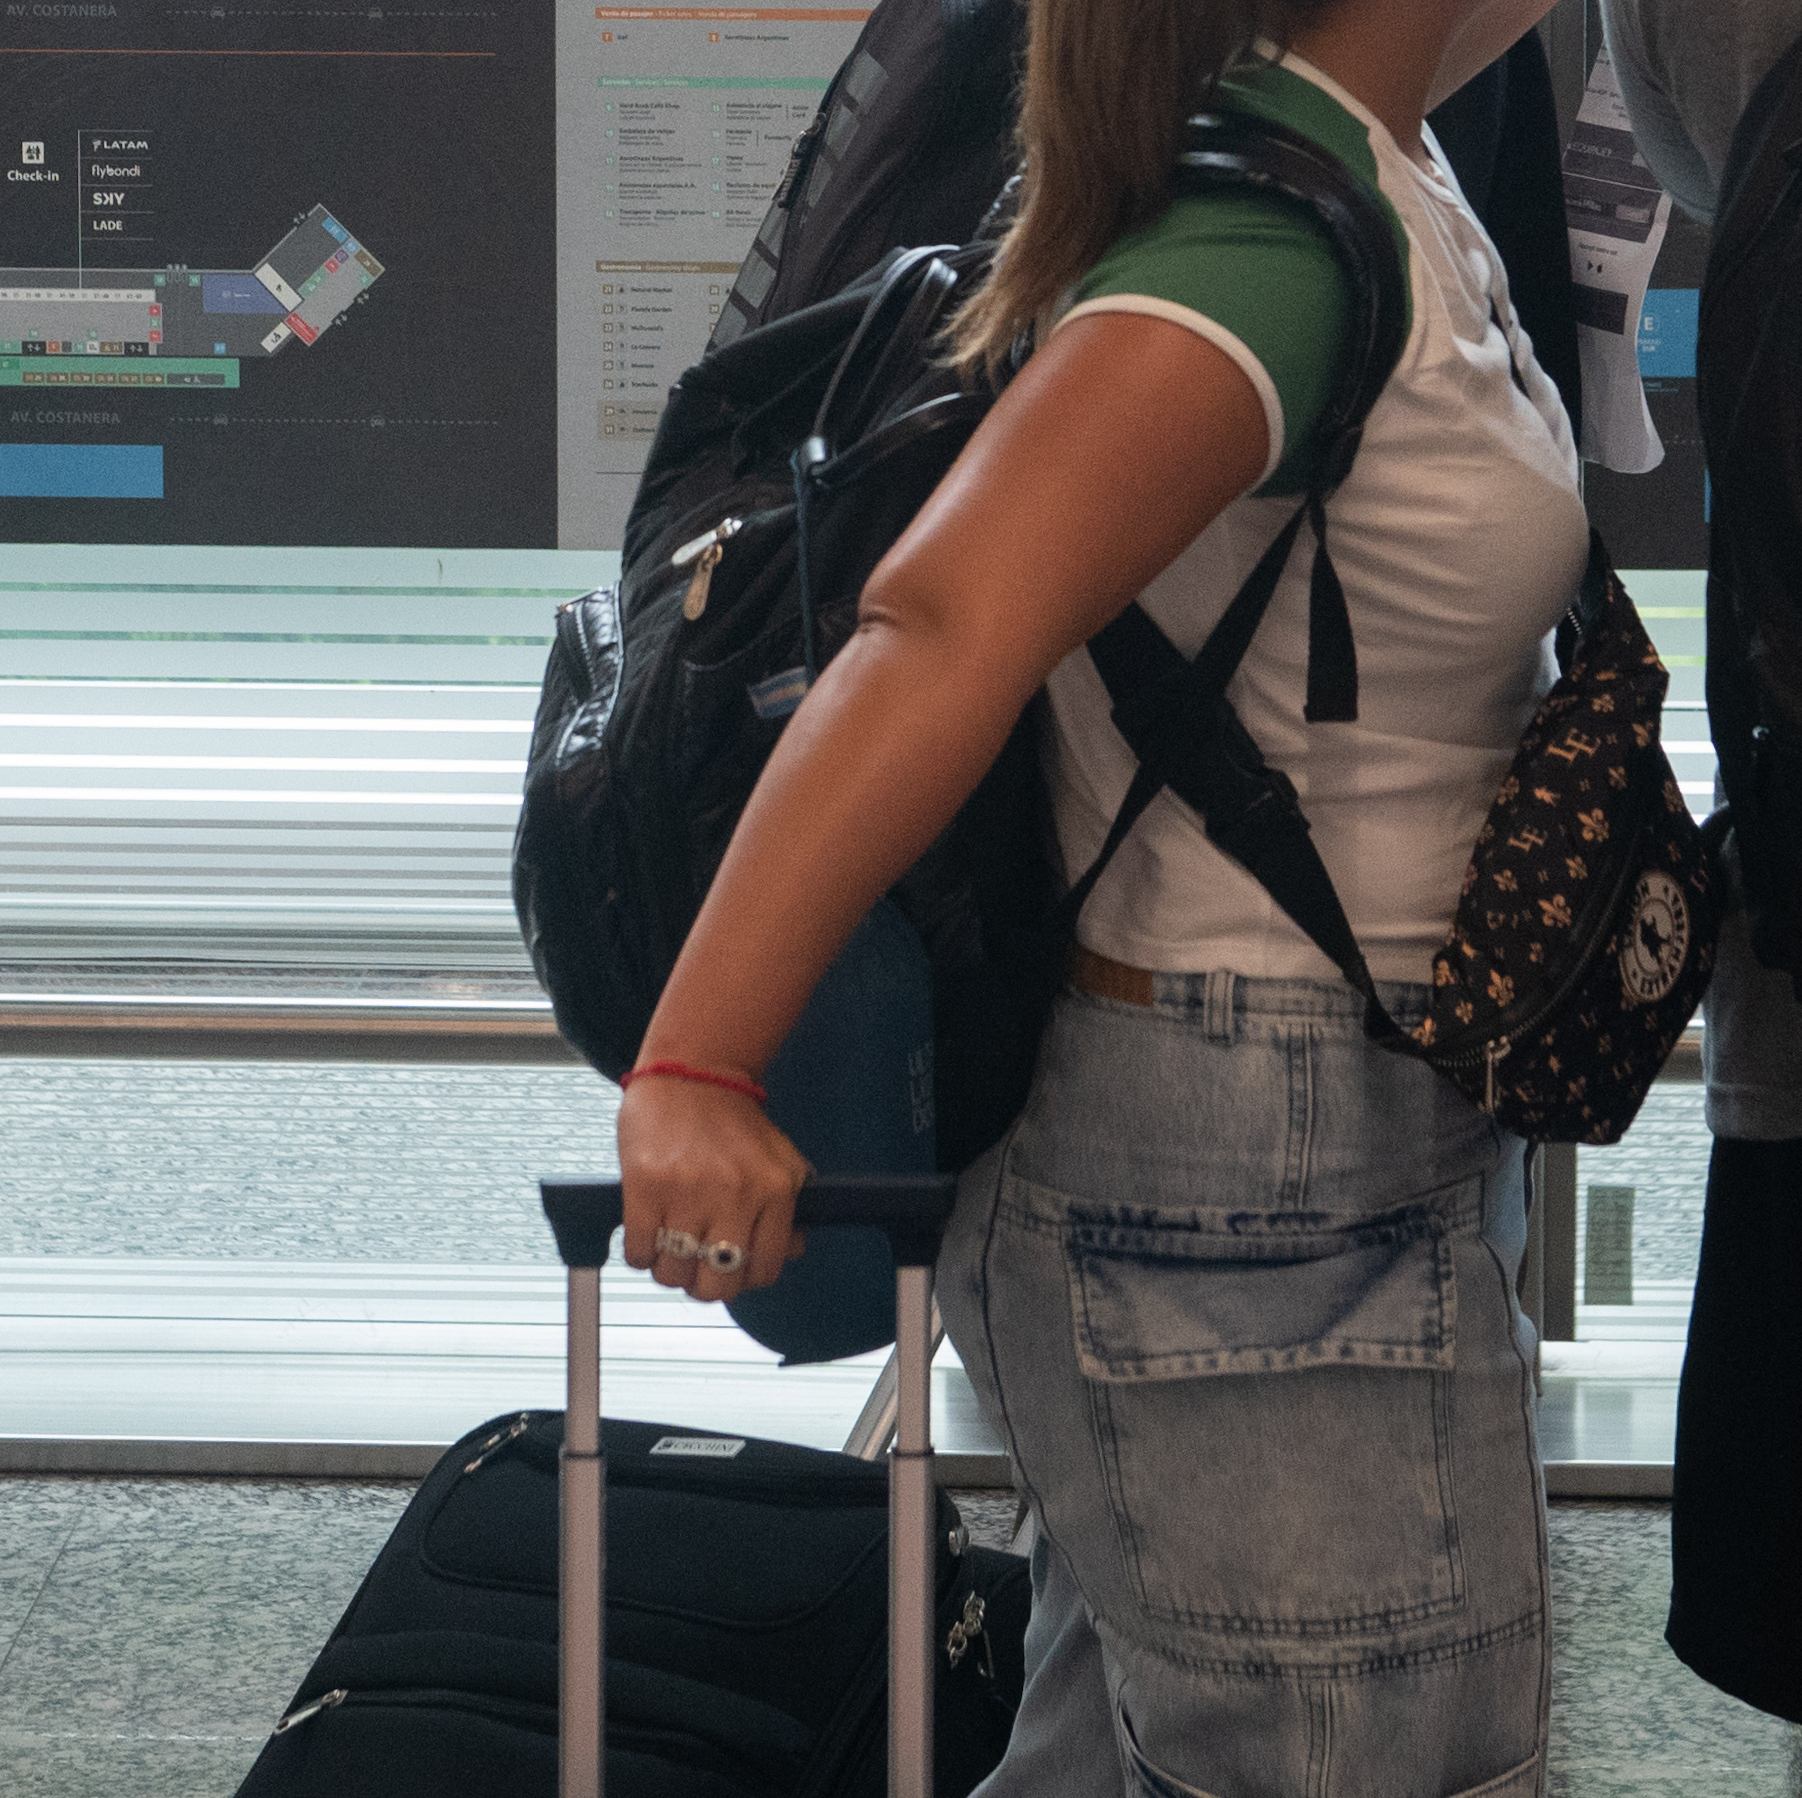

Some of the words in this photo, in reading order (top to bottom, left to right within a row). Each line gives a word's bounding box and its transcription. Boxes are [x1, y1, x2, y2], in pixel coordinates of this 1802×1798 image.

[103, 140, 149, 150] LATAM
[6, 169, 60, 182] Check-in
[93, 220, 123, 231] LADE
